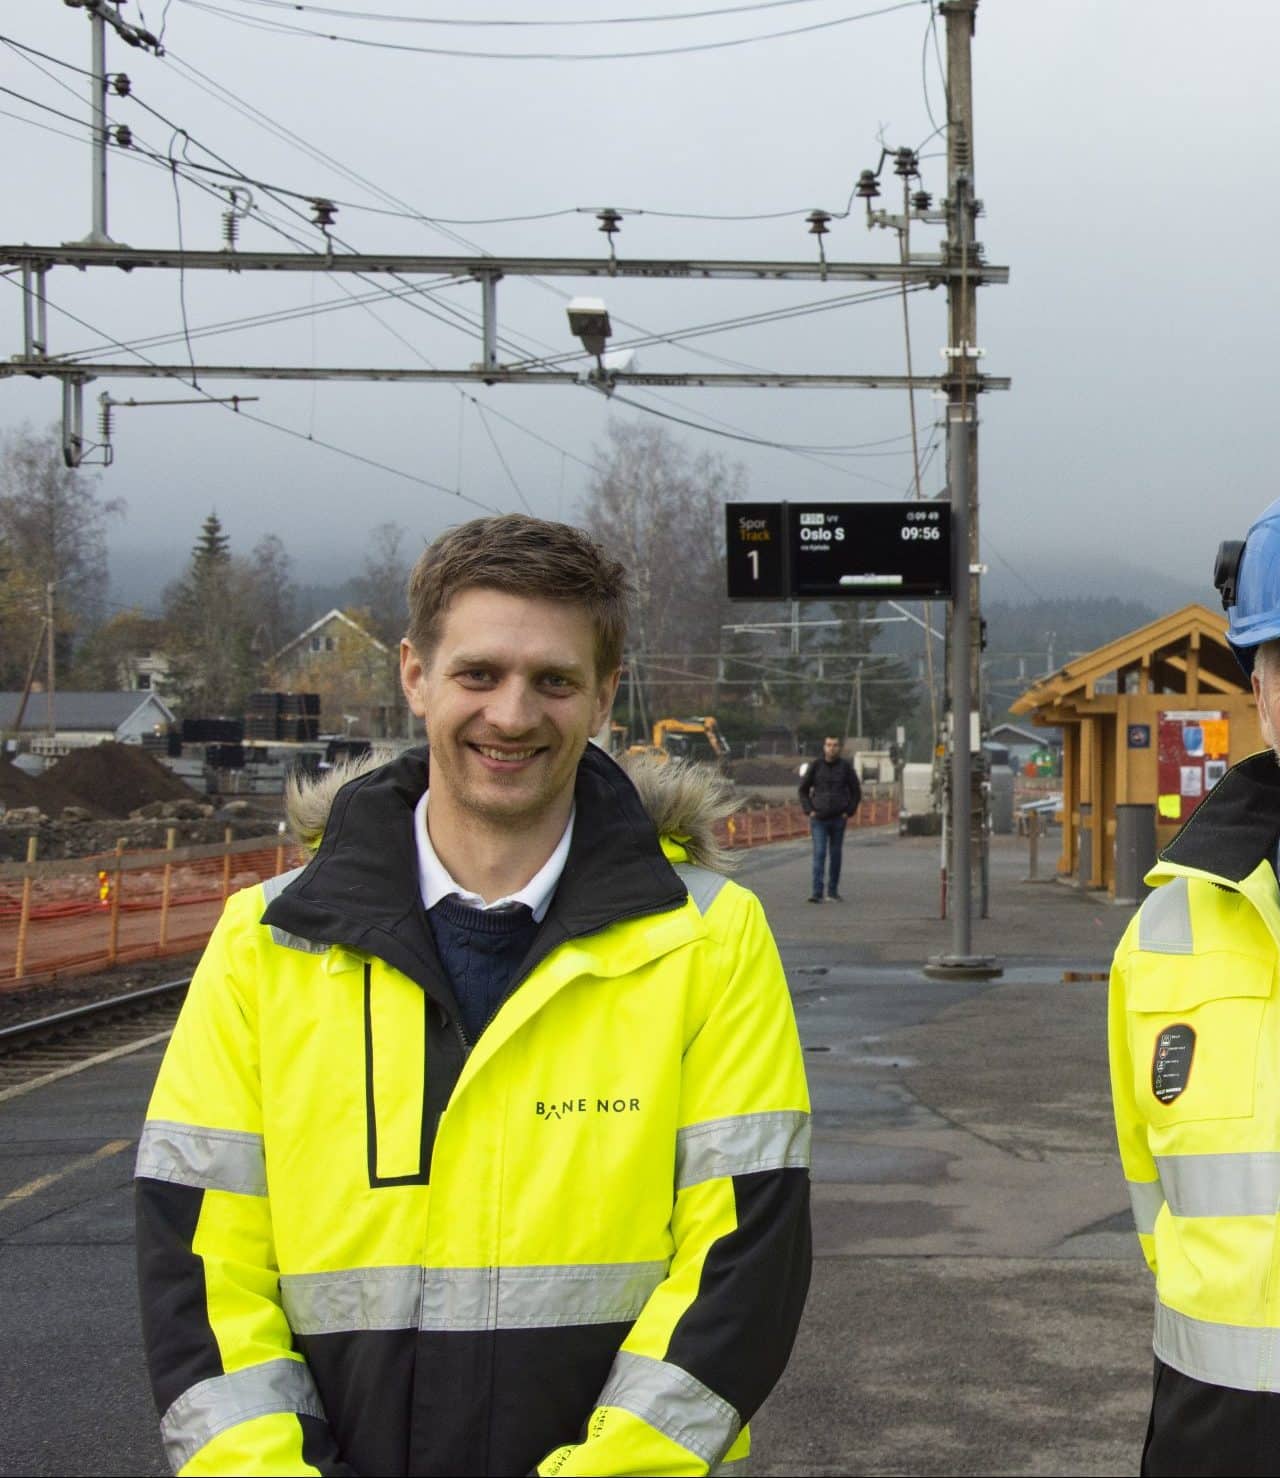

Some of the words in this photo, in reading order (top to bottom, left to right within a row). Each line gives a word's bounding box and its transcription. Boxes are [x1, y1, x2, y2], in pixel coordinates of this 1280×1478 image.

[739, 517, 766, 531] Spor
[740, 528, 770, 541] Track
[800, 527, 832, 541] Oslo
[834, 527, 845, 541] S
[901, 526, 940, 541] 09:56
[747, 550, 759, 580] 1
[536, 1099, 587, 1120] BANE
[597, 1098, 640, 1112] NOR
